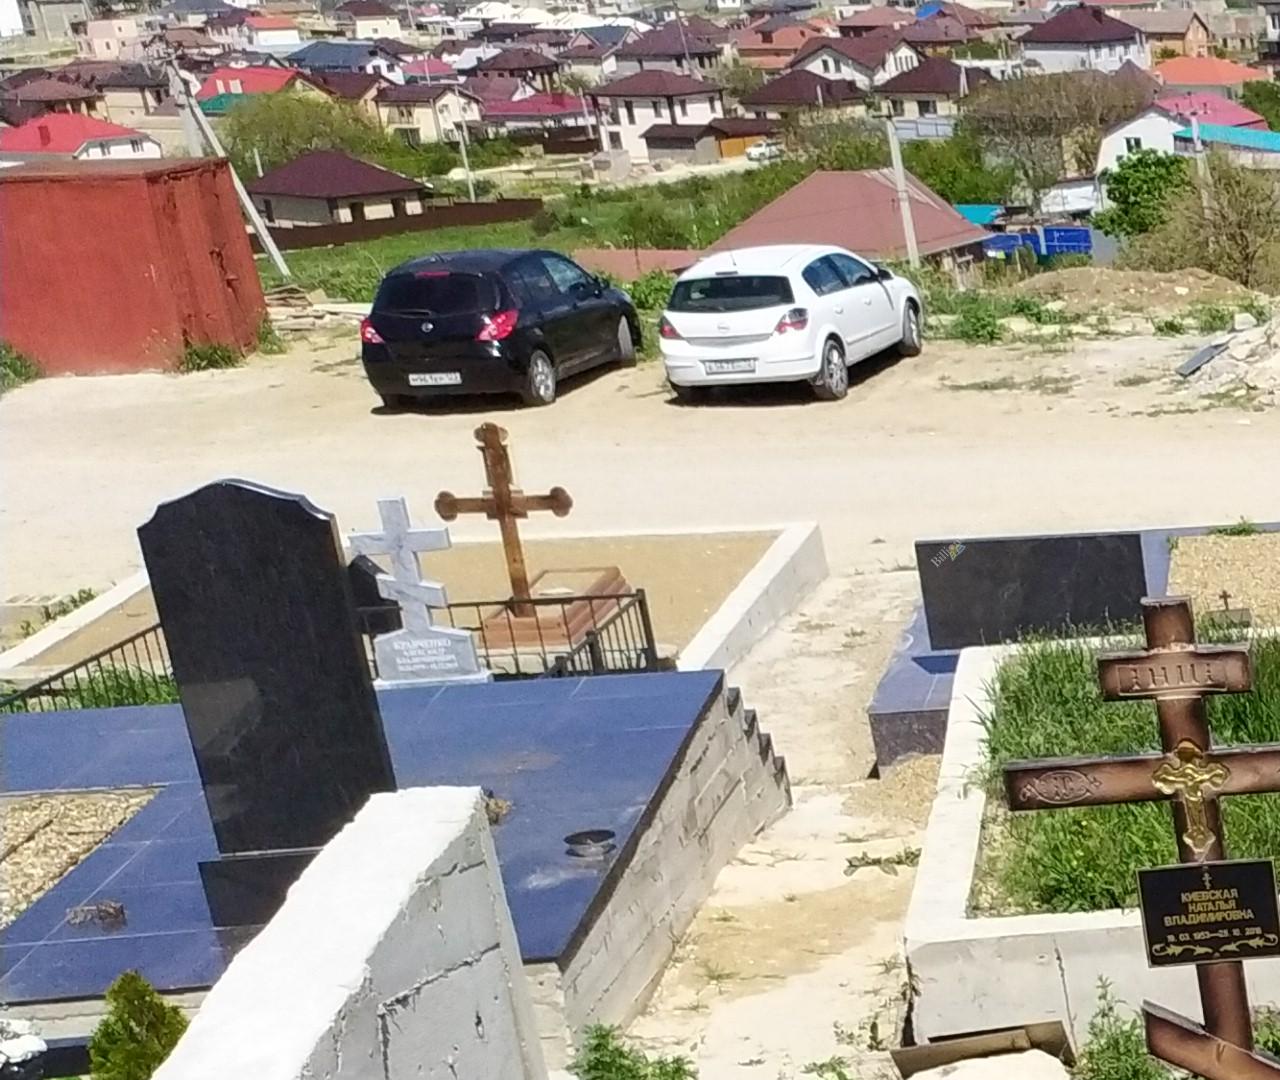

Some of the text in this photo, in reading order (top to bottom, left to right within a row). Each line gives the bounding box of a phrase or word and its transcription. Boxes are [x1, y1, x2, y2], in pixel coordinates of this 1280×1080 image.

[1181, 888, 1238, 903] КИЕВСКАЯ
[1188, 900, 1236, 913] НАТАЛЬЯ
[1164, 909, 1254, 927] ВЛАДИМИРОВНА
